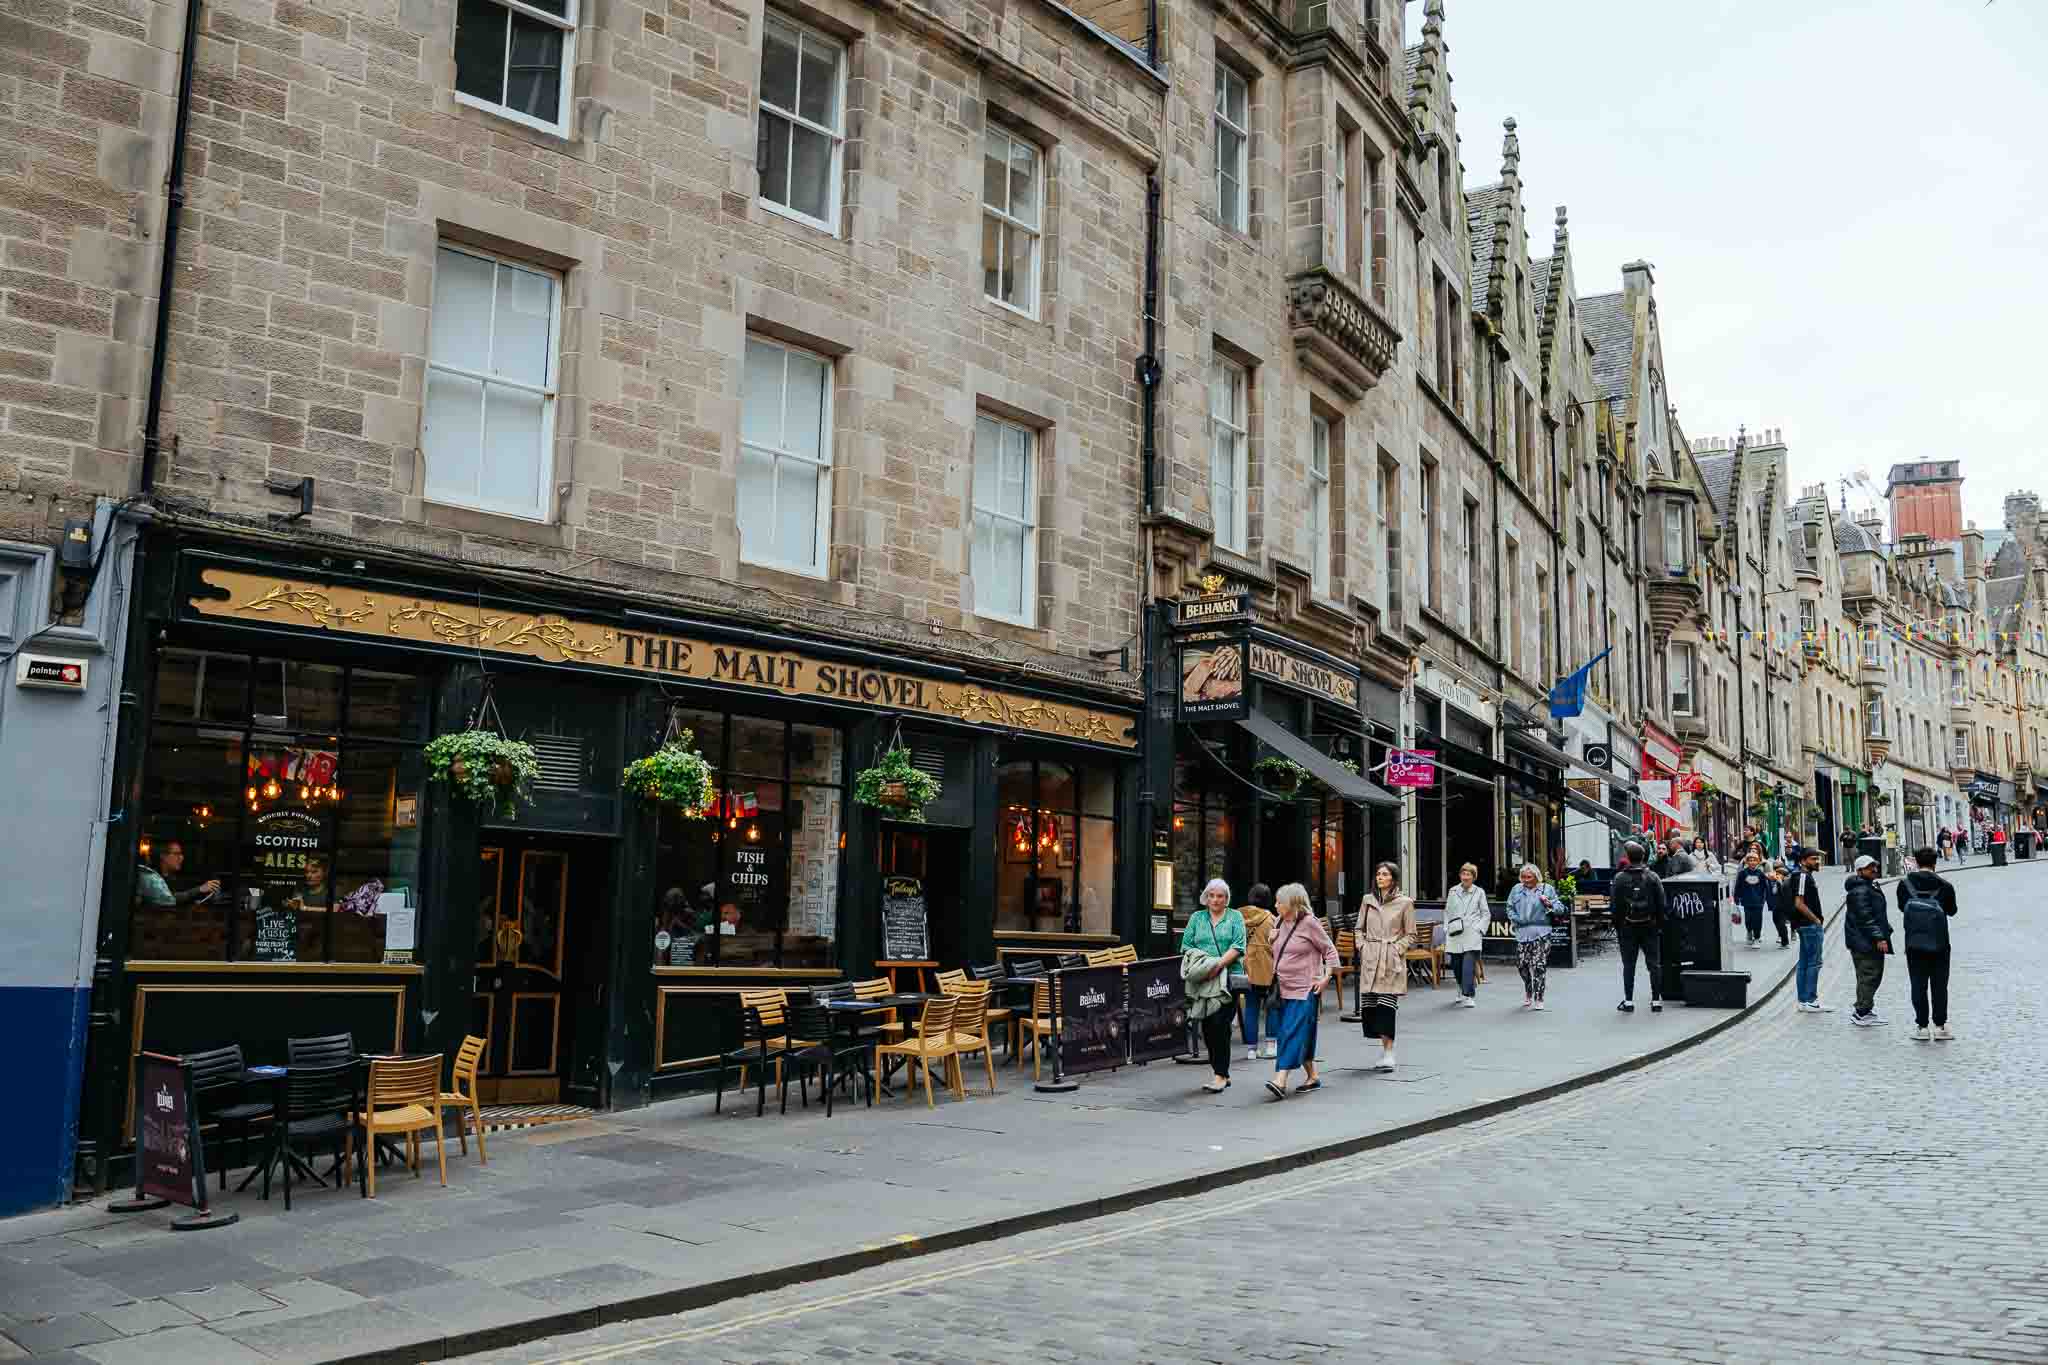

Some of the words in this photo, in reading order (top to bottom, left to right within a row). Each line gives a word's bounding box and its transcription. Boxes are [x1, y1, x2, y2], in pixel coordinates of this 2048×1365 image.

[1186, 598, 1238, 619] BELHAVEN
[30, 666, 60, 676] pointer
[616, 632, 693, 673] THE
[712, 647, 802, 688] MALT
[816, 665, 930, 708] SHOVEL
[1251, 646, 1287, 678] MALT
[1290, 661, 1335, 695] SHOVEL
[1184, 705, 1197, 713] THE
[1198, 703, 1214, 712] MALT
[1215, 701, 1240, 711] SHOVEL
[255, 834, 319, 849] SCOTTISH
[263, 851, 305, 868] ALES
[736, 851, 765, 864] FISH
[746, 863, 753, 873] &
[731, 872, 769, 886] CHIPS
[263, 919, 285, 929] LIVE
[258, 928, 289, 939] MUSIC
